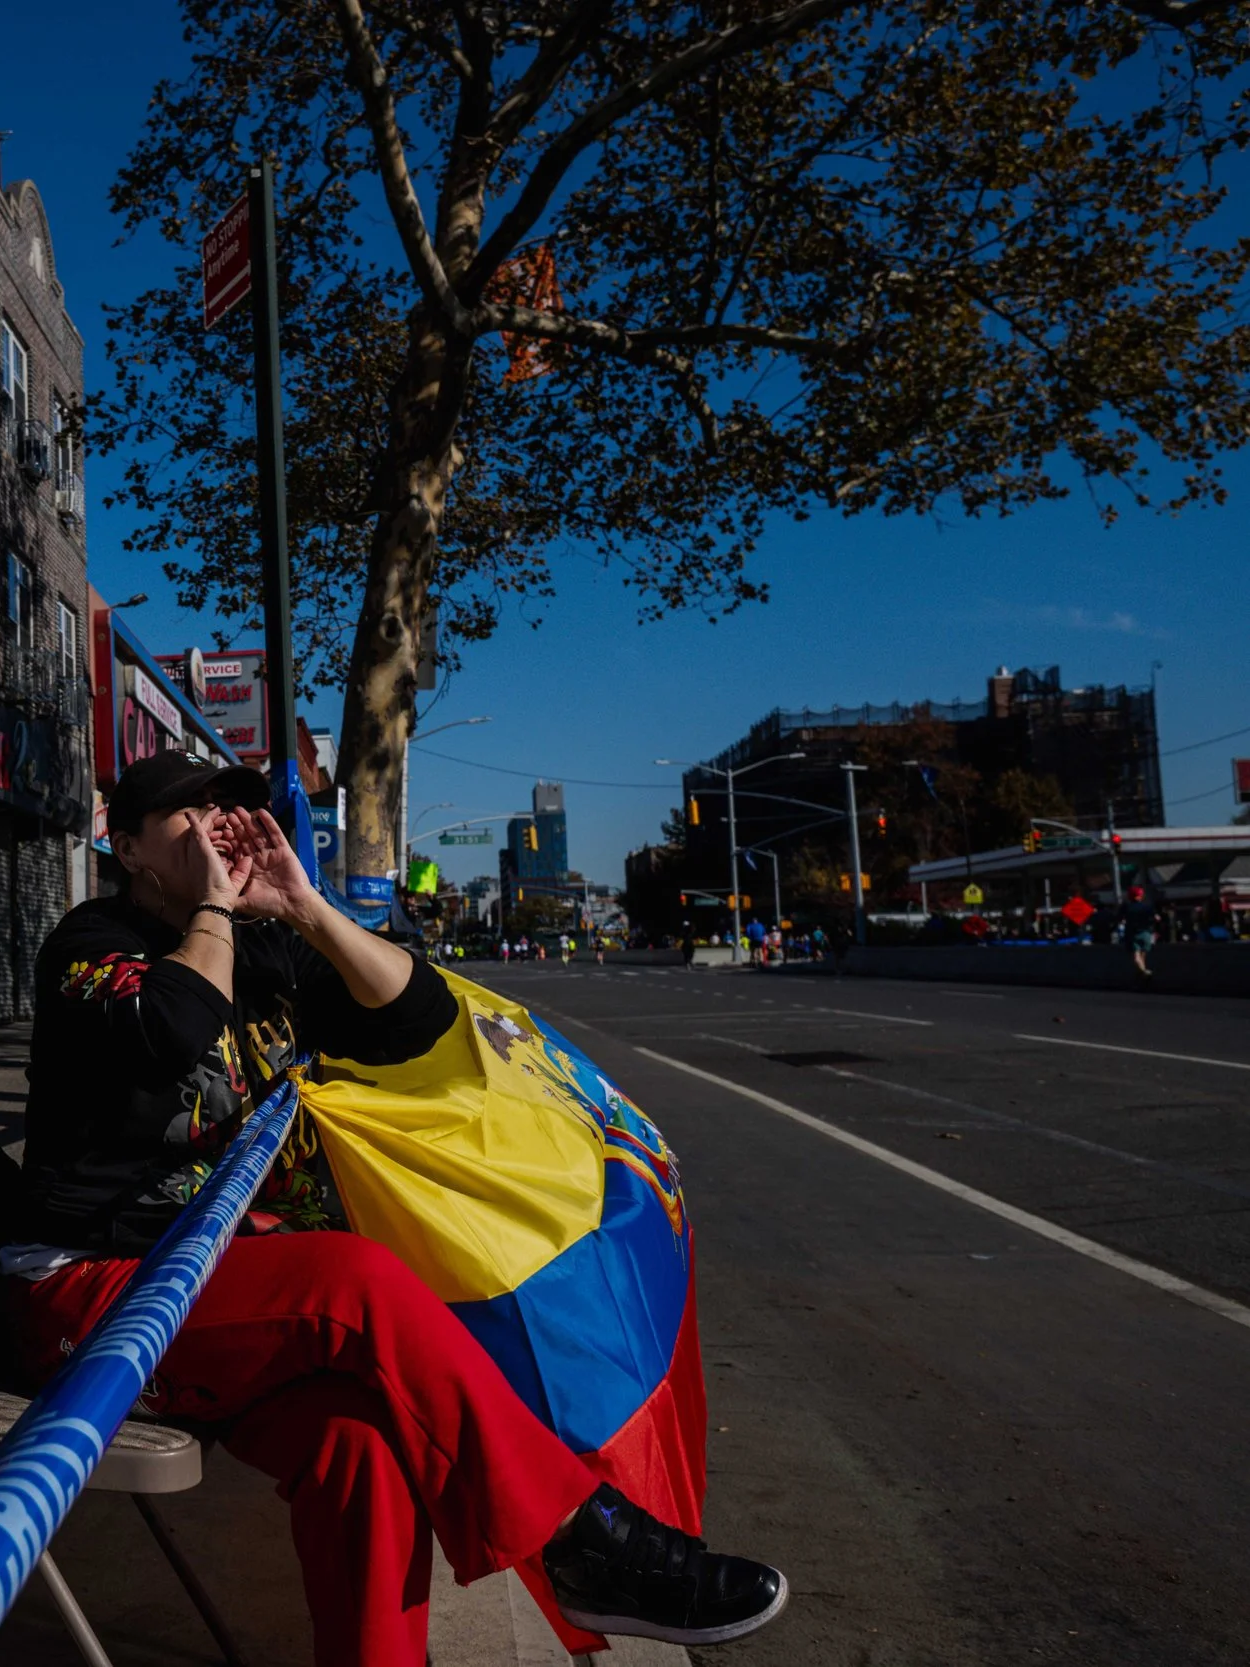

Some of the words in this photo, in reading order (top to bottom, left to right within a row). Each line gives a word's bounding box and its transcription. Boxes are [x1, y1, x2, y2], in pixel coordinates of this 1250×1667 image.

[206, 237, 217, 260] NO
[218, 201, 250, 248] STOPPI
[207, 240, 240, 281] Anytime
[204, 663, 241, 675] RVICE
[141, 676, 158, 712] FULL
[205, 683, 252, 702] WASH
